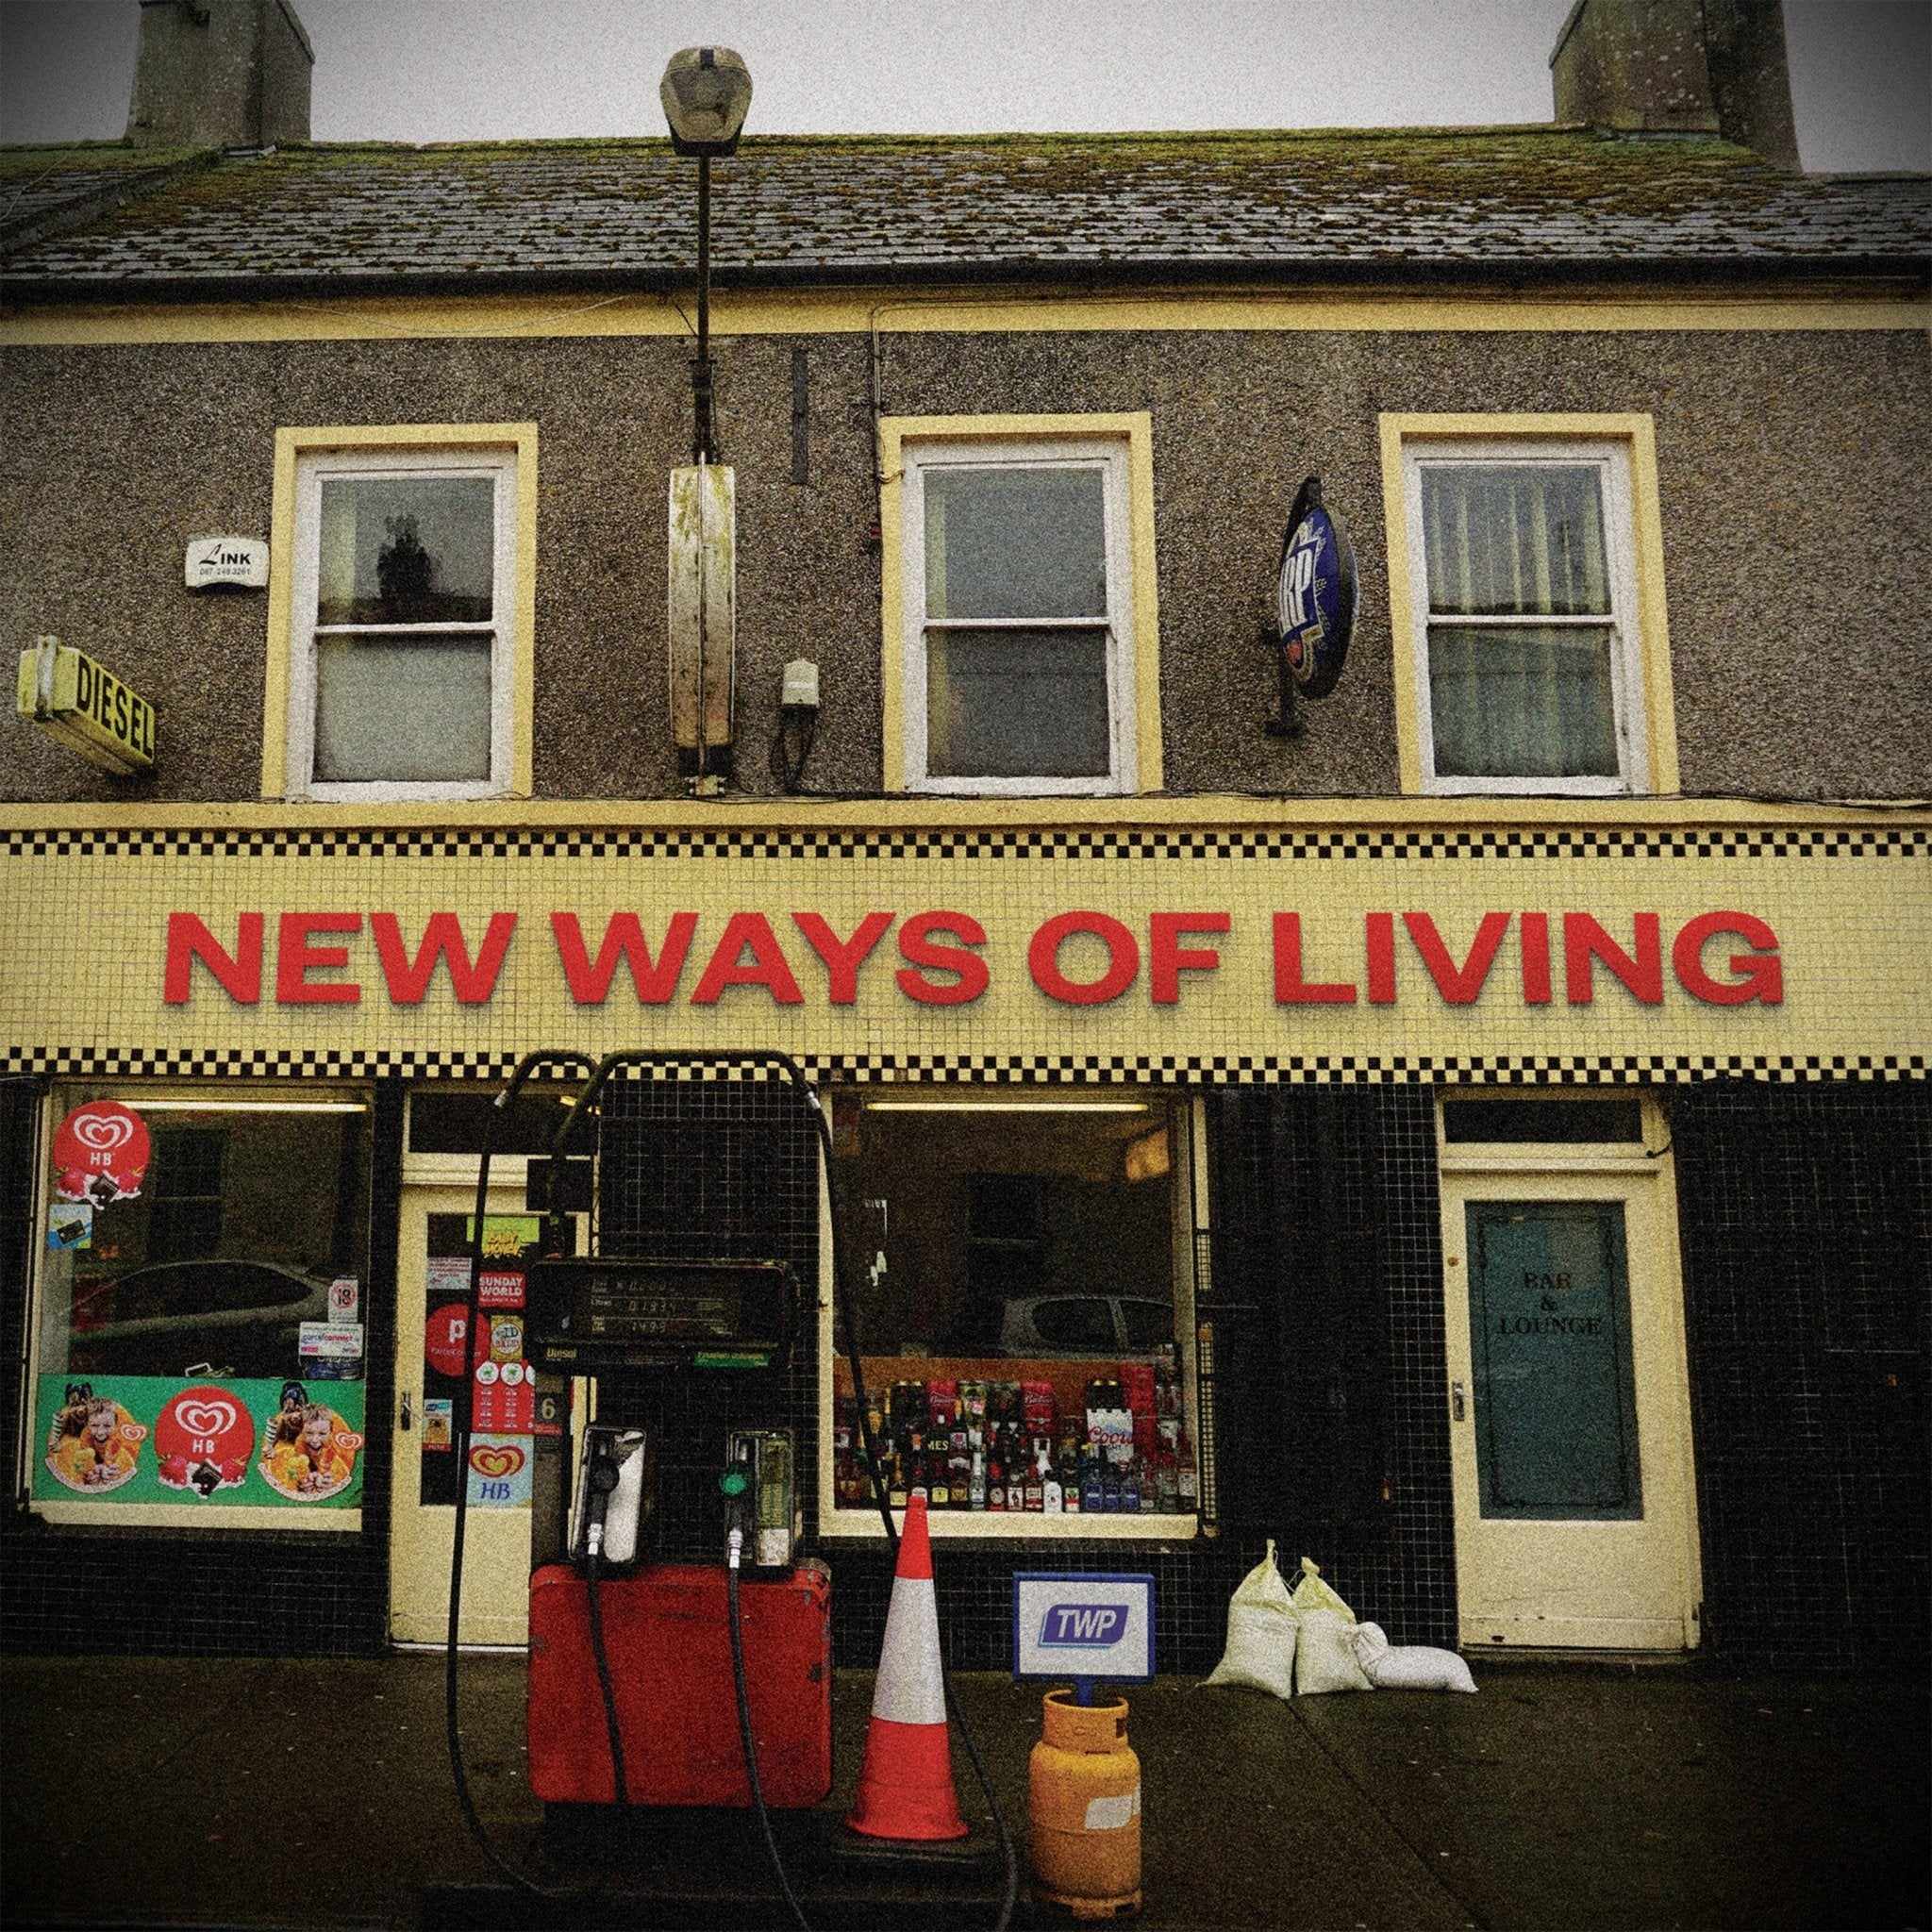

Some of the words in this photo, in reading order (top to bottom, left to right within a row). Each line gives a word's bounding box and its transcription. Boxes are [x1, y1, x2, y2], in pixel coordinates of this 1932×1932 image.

[199, 543, 251, 565] LINK
[76, 655, 153, 759] DIESEL
[164, 911, 518, 1008] NEW
[550, 910, 989, 1008] WAYS
[1028, 910, 1230, 1007] OF
[1273, 910, 1783, 1008] LIVING
[91, 1152, 111, 1166] HB
[478, 1276, 523, 1287] SUNDAY
[1523, 1272, 1573, 1290] BAR
[338, 1289, 351, 1305] 18
[479, 1286, 522, 1297] WORLD
[1540, 1295, 1557, 1311] &
[1496, 1317, 1603, 1335] LOUNGE
[192, 1439, 214, 1454] HB
[480, 1482, 510, 1500] HB
[1057, 1607, 1118, 1639] TWP
